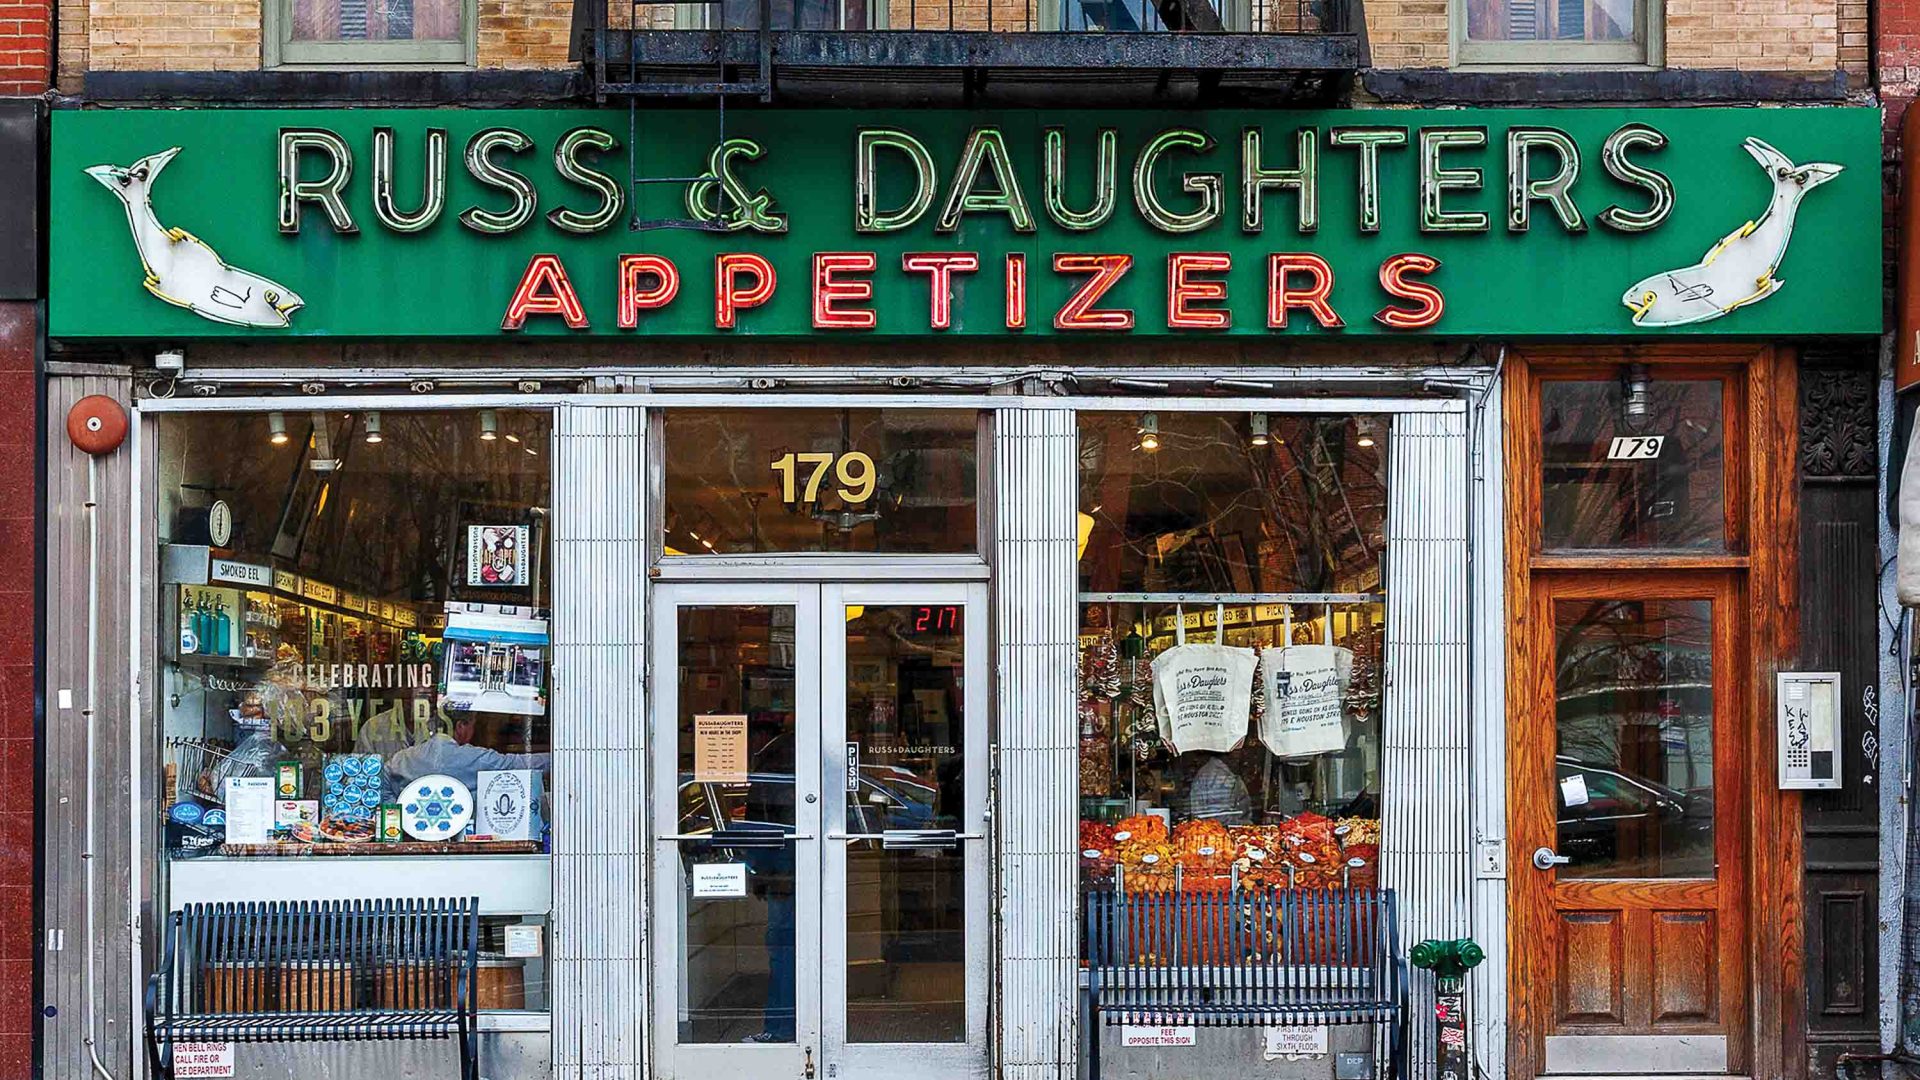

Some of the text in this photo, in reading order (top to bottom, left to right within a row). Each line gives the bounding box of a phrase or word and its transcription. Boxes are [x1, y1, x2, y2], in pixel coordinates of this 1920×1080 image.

[278, 122, 1676, 234] RUSS & DAUGHTERS
[502, 253, 1446, 329] APPETIZERS
[1613, 438, 1660, 458] 179
[771, 451, 877, 504] 179
[220, 563, 260, 581] SMOKED EEL
[1184, 614, 1198, 626] FISH
[293, 663, 433, 688] CELEBRATING
[346, 697, 455, 742] YEARS
[848, 746, 857, 787] PUSH
[1160, 1028, 1177, 1037] FEET
[1276, 1024, 1295, 1033] FIRST
[1128, 1036, 1191, 1045] OPPOSITE THIS SIGN
[1283, 1034, 1313, 1042] THROUGH
[188, 1043, 206, 1053] BELL
[206, 1042, 227, 1051] RINGS
[1276, 1042, 1319, 1051] SIXTH FLOOR
[175, 1054, 220, 1064] CALL FIRE OR
[188, 1065, 232, 1076] DEPARTMENT
